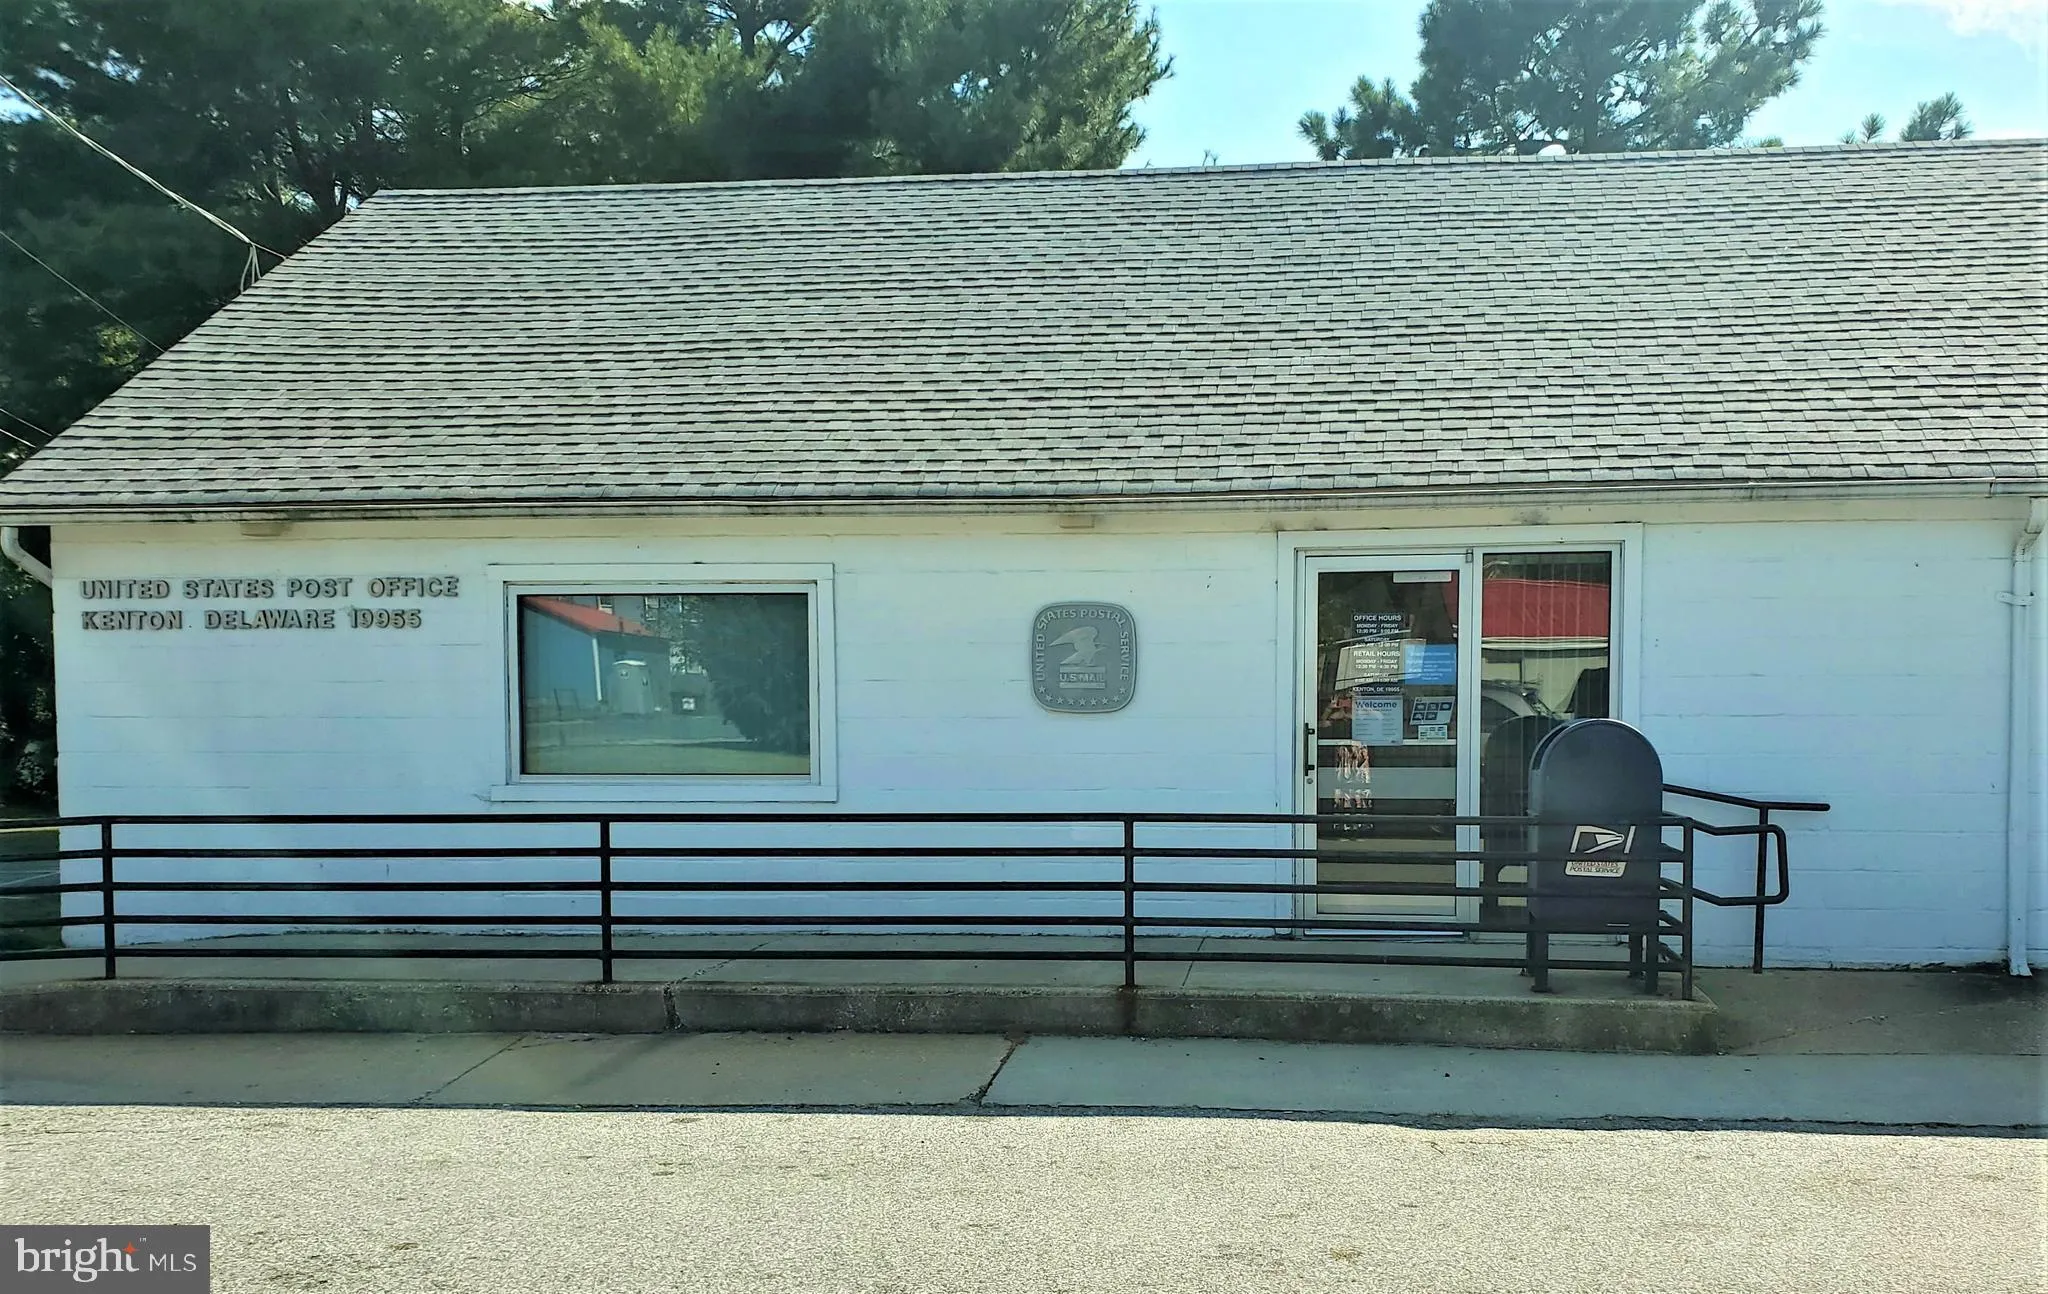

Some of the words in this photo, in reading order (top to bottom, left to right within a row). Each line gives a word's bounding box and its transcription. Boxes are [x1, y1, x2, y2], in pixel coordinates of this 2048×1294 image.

[80, 580, 170, 600] UNITED
[183, 579, 275, 599] STATES
[287, 578, 353, 598] POST
[368, 576, 459, 598] OFFICE
[81, 610, 183, 631] KENTON
[204, 609, 336, 630] DELAWARE
[349, 609, 423, 629] 19955
[1038, 609, 1077, 630] STATES
[1080, 609, 1126, 628] POSTAL
[1036, 634, 1046, 681] UNITED
[1120, 631, 1130, 681] SERVICE
